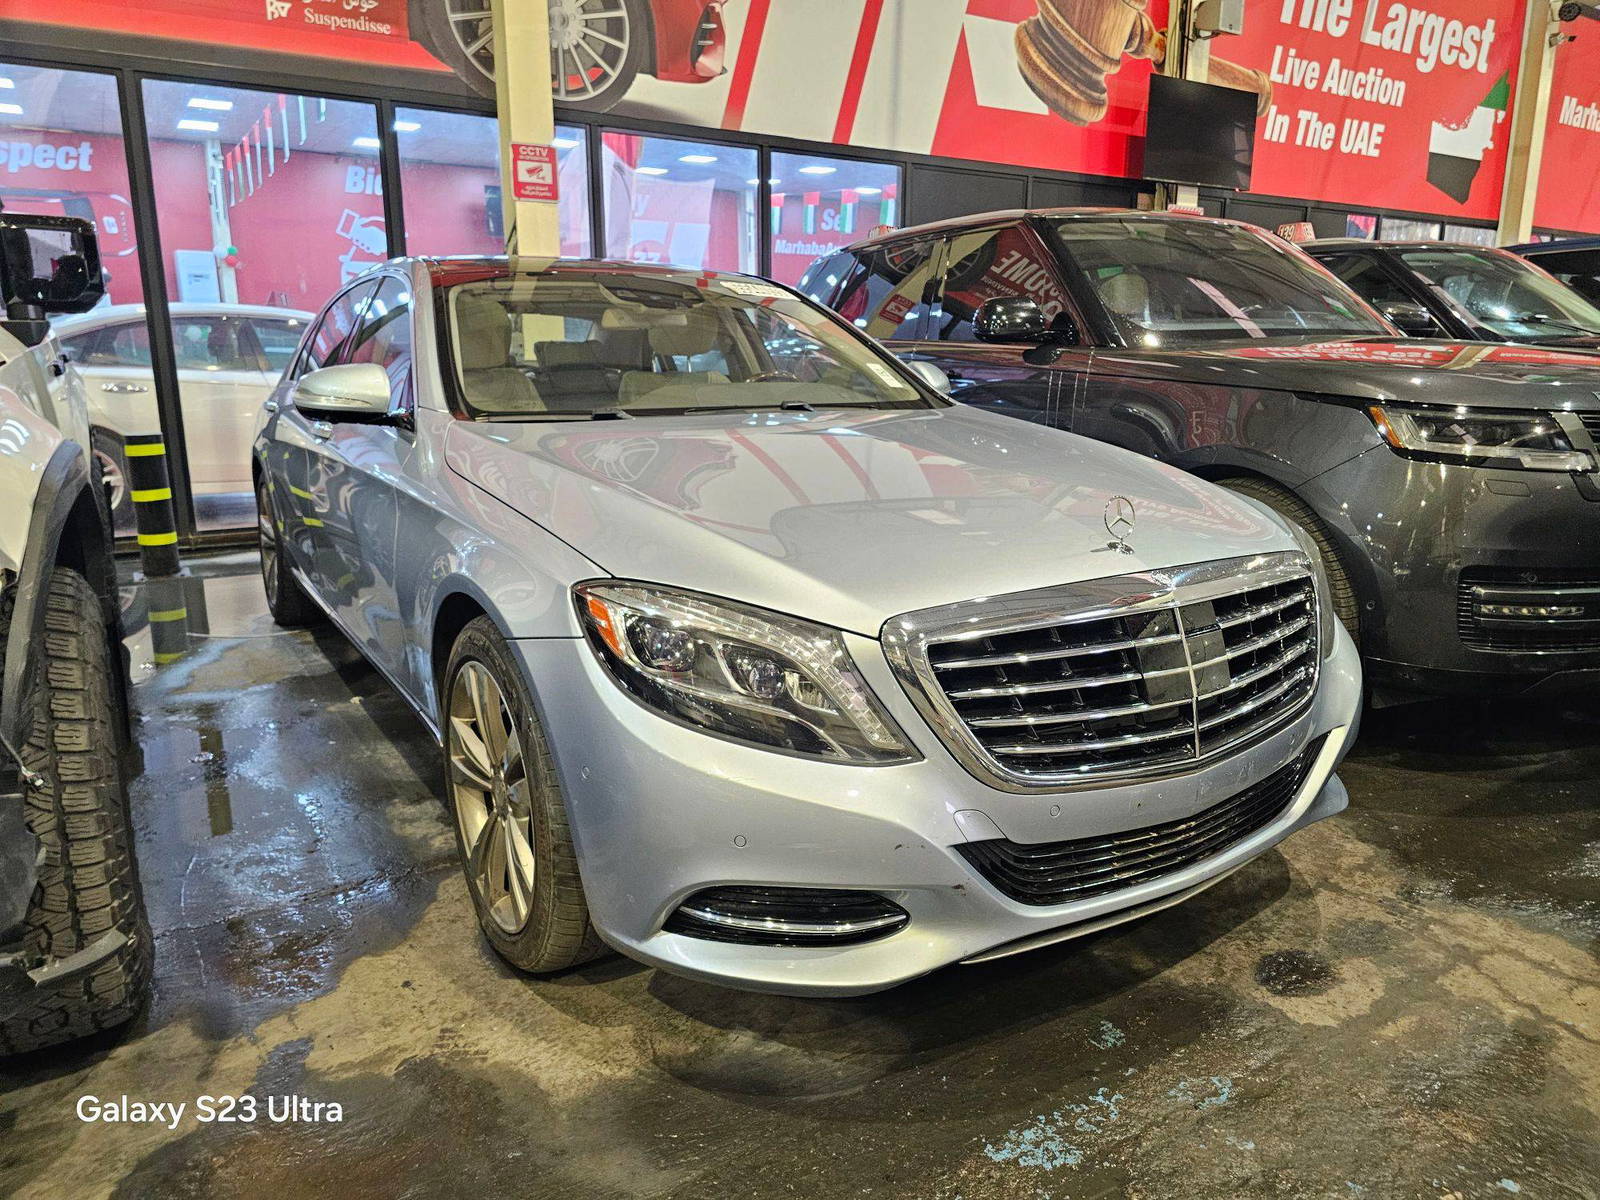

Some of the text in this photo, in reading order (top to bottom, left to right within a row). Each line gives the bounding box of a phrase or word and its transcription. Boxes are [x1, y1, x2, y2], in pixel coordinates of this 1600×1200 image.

[304, 8, 391, 35] Suspendisse
[1360, 0, 1496, 74] Largest
[1269, 45, 1406, 108] Live Auction
[519, 145, 549, 158] CCTV
[1263, 104, 1386, 158] In The UAE
